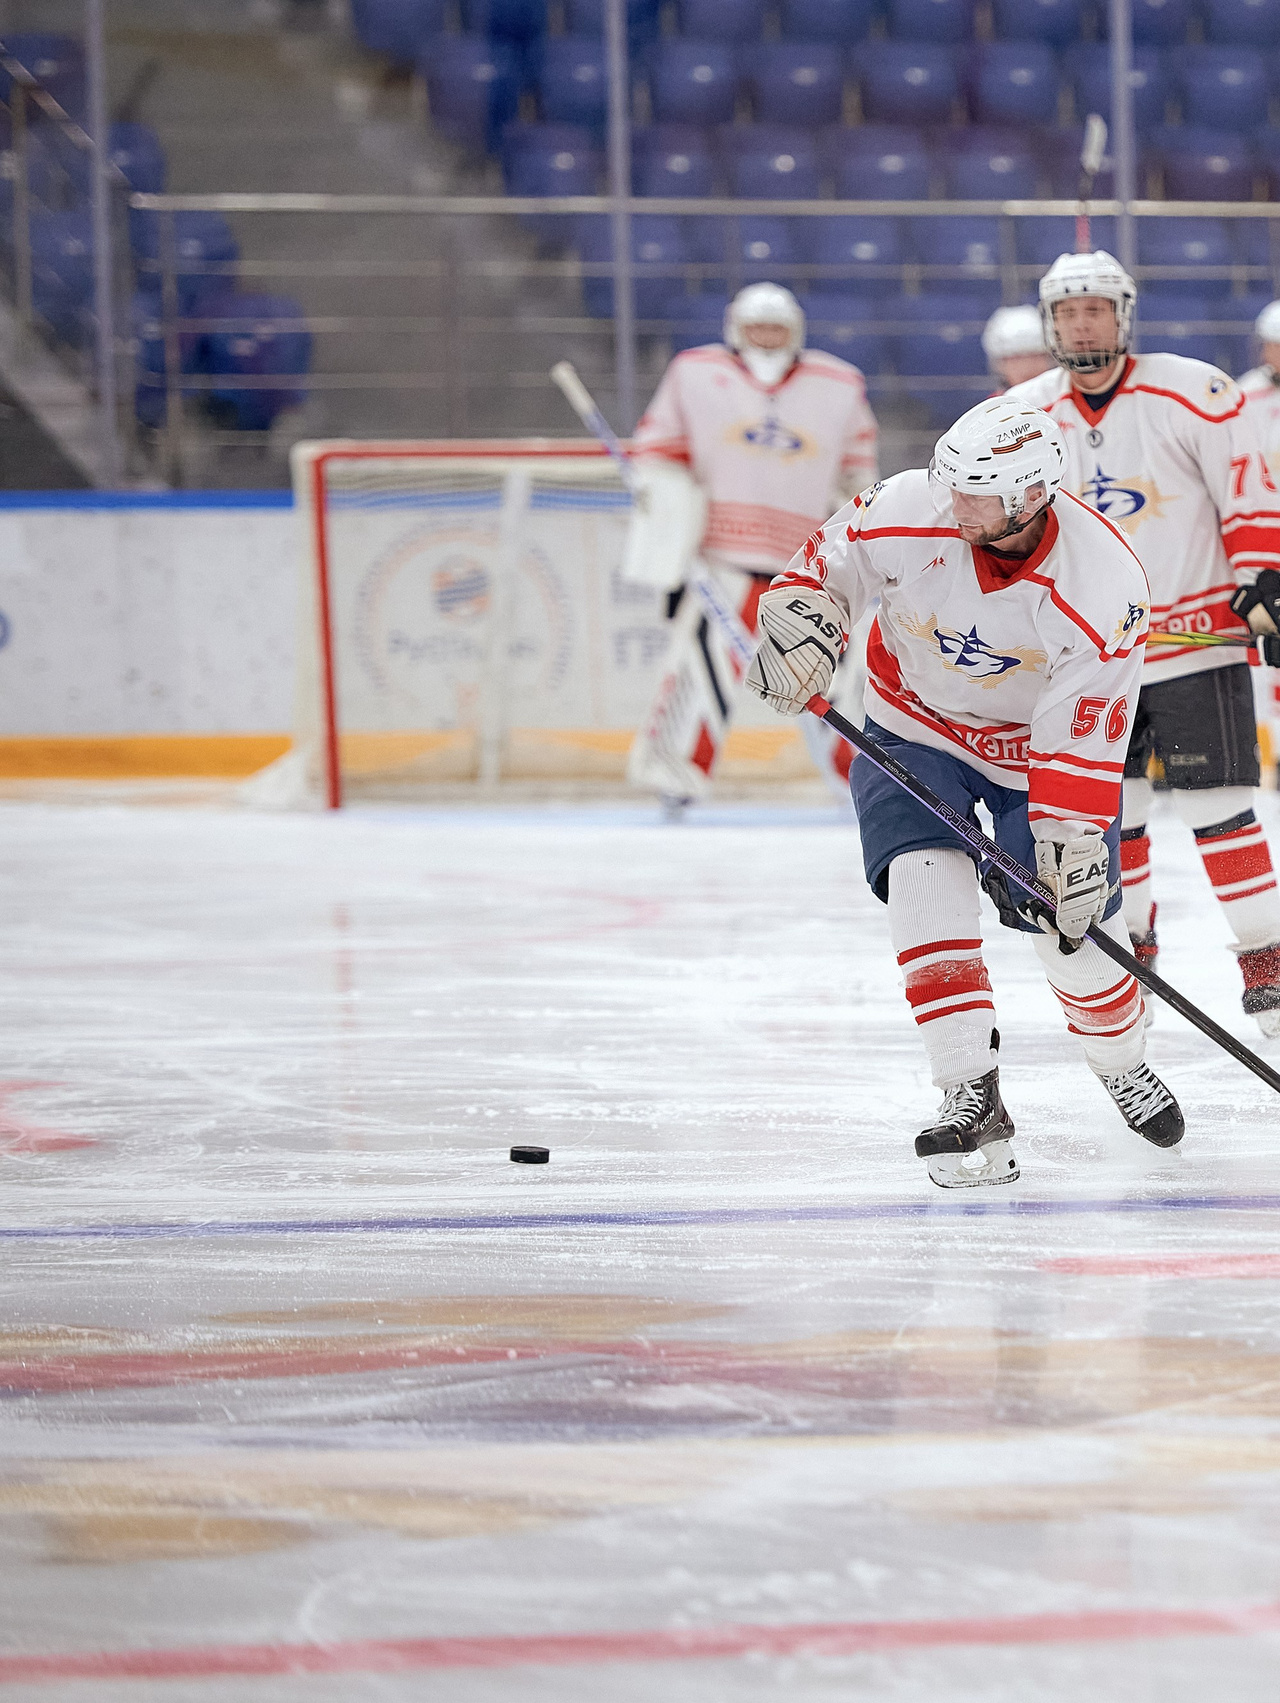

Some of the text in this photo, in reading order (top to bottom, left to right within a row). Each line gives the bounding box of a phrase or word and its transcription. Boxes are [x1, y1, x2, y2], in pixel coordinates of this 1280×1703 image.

[1010, 422, 1031, 438] МИР
[938, 459, 957, 474] CCM
[1014, 467, 1042, 484] CCM
[1070, 695, 1127, 744] 56
[935, 800, 1033, 885] RIBCOR
